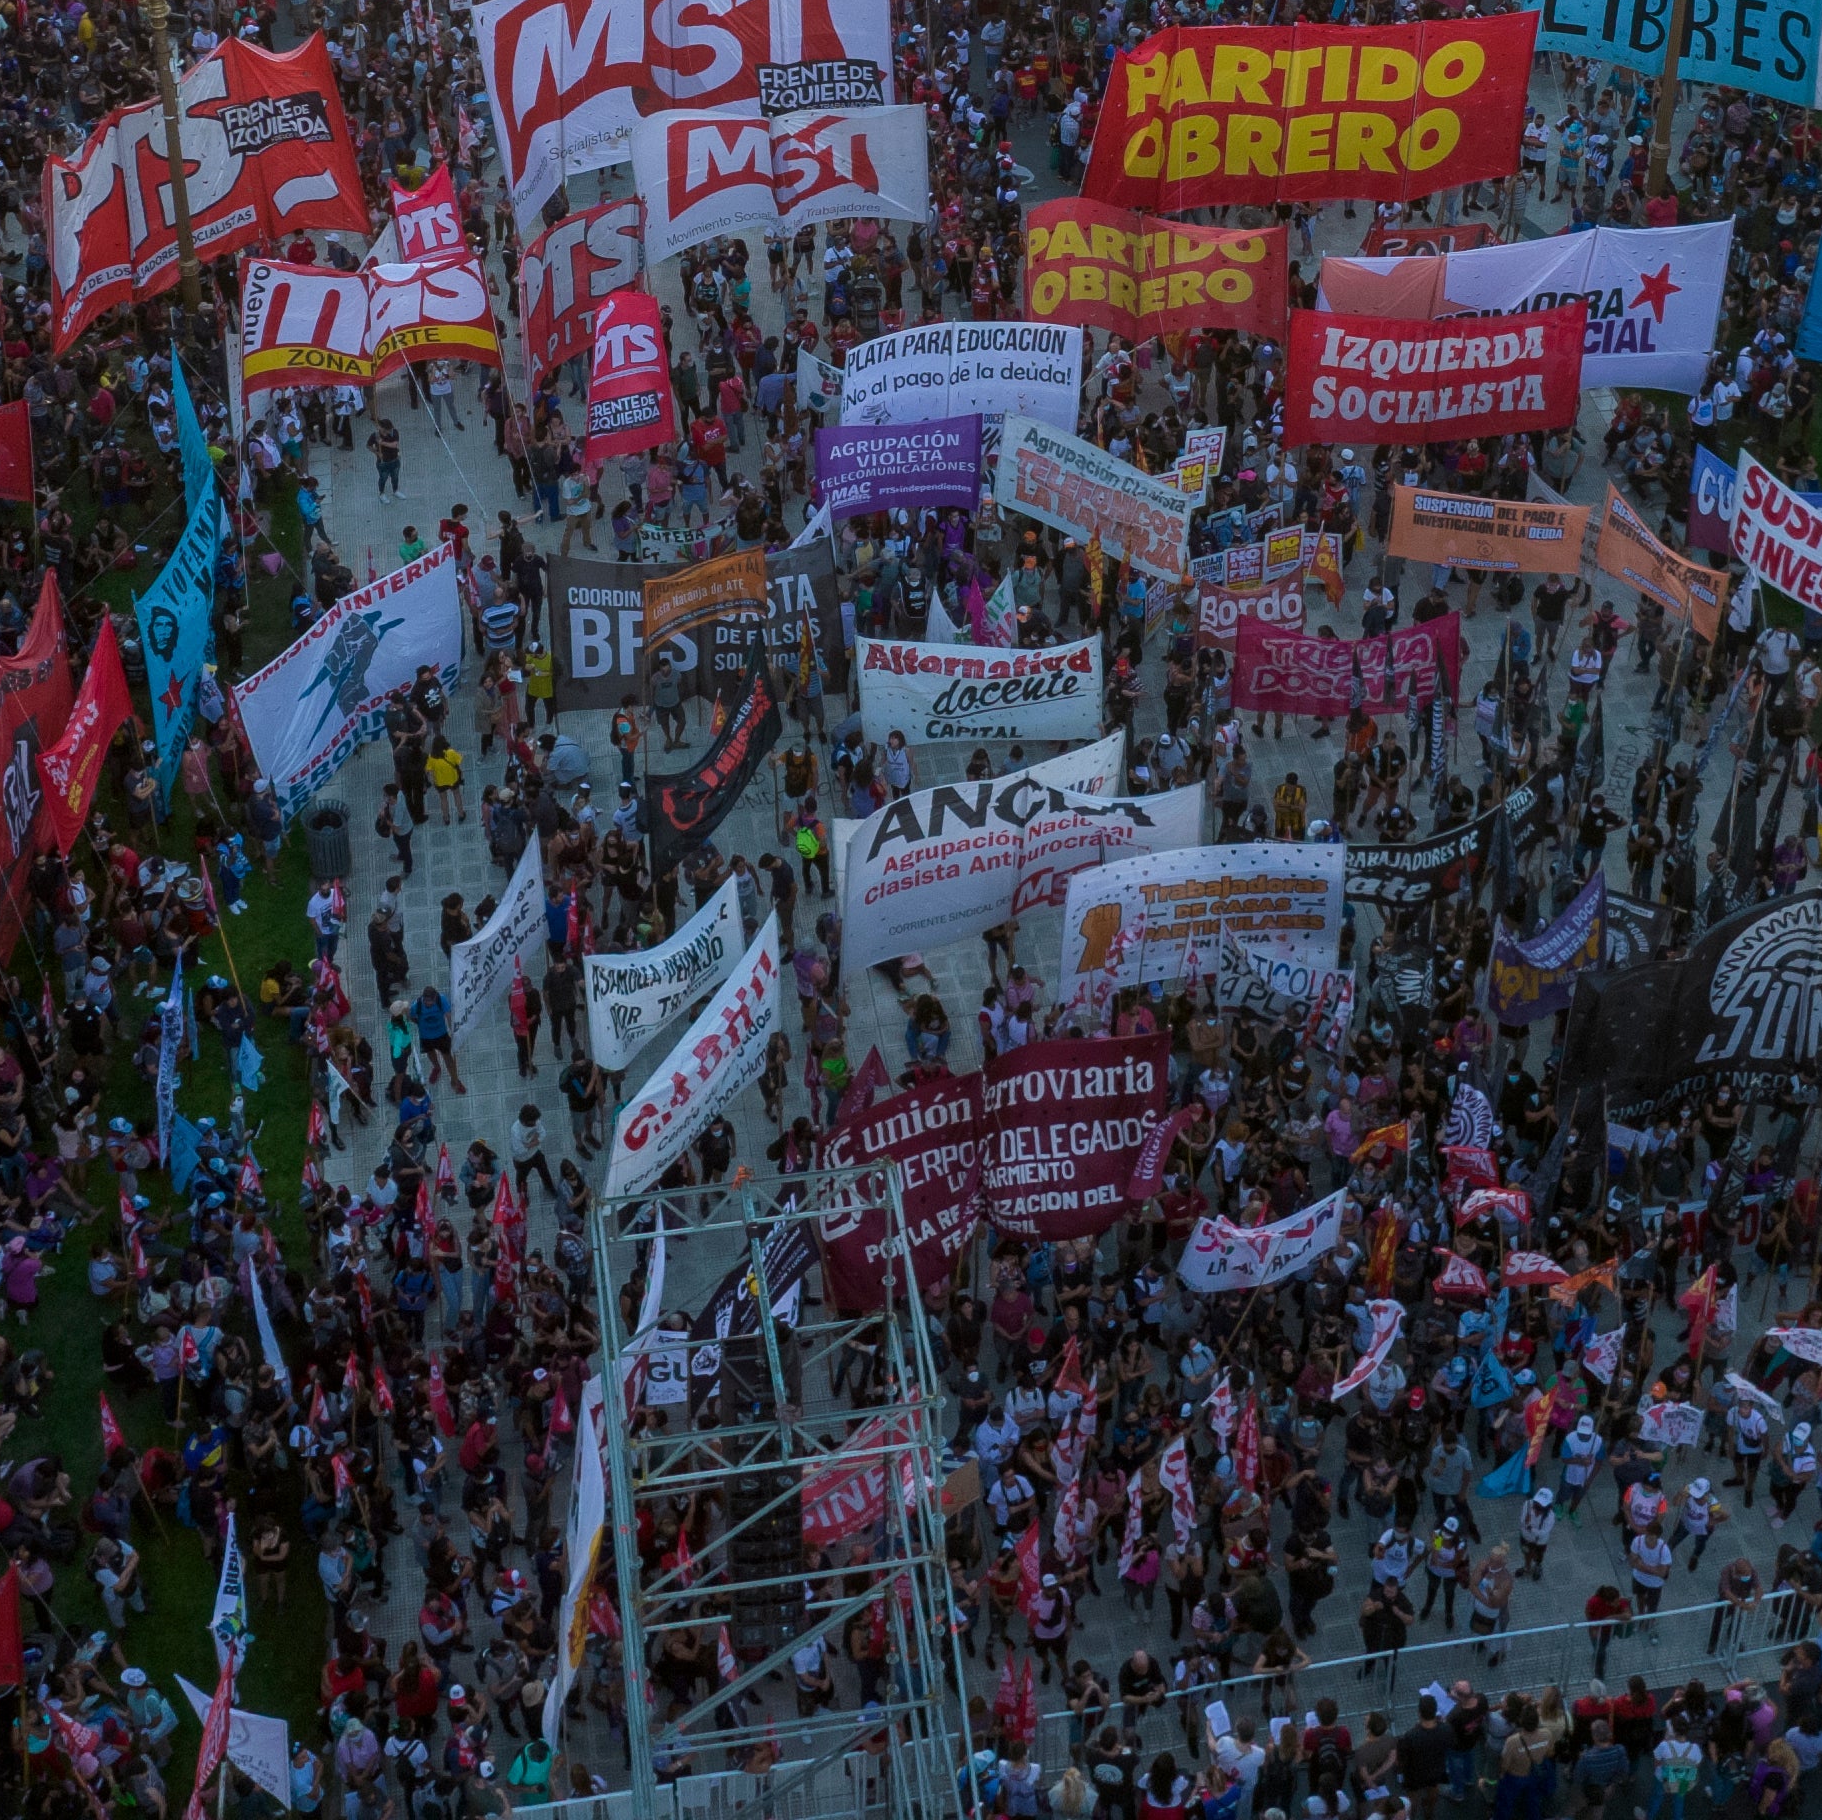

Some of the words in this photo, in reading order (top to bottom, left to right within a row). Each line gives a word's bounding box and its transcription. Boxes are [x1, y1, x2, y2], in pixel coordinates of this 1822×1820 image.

[759, 63, 846, 86] FRENTE
[848, 66, 875, 83] DE
[1127, 39, 1485, 117] PARTIDO
[760, 84, 882, 105] IZQUIERDA
[223, 98, 292, 129] FRENTE
[292, 103, 311, 117] DE
[549, 135, 610, 162] Socialista
[1123, 107, 1462, 183] OBRERO
[52, 56, 256, 303] PTS
[686, 125, 864, 204] MST
[400, 201, 462, 249] PTS
[666, 216, 731, 248] Movimiento
[805, 203, 880, 219] Trabajadores
[1029, 220, 1268, 274] PARTIDO
[243, 265, 272, 347] nuevo
[1031, 265, 1256, 321] OBRERO
[594, 323, 659, 368] PTS
[902, 329, 953, 358] PARA
[956, 325, 1067, 355] EDUCACIÓN
[1318, 325, 1547, 377] IZQUIERDA
[287, 347, 362, 374] ZONA
[872, 378, 889, 397] al
[893, 370, 945, 397] pago
[949, 363, 971, 385] de
[975, 361, 996, 380] la
[999, 361, 1072, 389] deuda!
[1310, 371, 1548, 427] SOCIALISTA
[829, 431, 962, 461] AGRUPACIÓN
[1187, 431, 1222, 450] NO
[855, 448, 944, 468] VIOLETA
[1179, 461, 1205, 479] NO
[819, 460, 977, 491] TELECOMUNICACIONES
[831, 482, 872, 503] MAC
[1413, 494, 1495, 519] SUSPENSIÓN
[1522, 504, 1555, 524] PAGO
[640, 529, 705, 546] SUTEBA
[1269, 537, 1294, 553] NO
[1527, 526, 1564, 542] DEUDA
[1228, 547, 1262, 565] NO
[341, 541, 457, 614] INTERNA
[684, 588, 721, 612] Naranja
[715, 626, 741, 645] DE
[1261, 634, 1438, 674] TRIBUNA
[933, 669, 1082, 718] docente
[1250, 667, 1438, 699] DOCENTE
[925, 720, 1024, 741] CAPITAL
[882, 830, 1025, 874] Agrupación
[864, 866, 980, 906] Clasista
[1140, 876, 1329, 905] Trabajadoras
[888, 910, 951, 936] CORRIENTE
[953, 902, 995, 922] SINDICAL
[1175, 901, 1205, 919] DE
[1210, 896, 1291, 918] CASAS
[1140, 915, 1326, 944] PARTICULARES
[1607, 1075, 1707, 1124] SINDICATO
[862, 1096, 974, 1154] unión
[998, 1111, 1158, 1161] DELEGADOS
[1082, 1185, 1124, 1209] DEL
